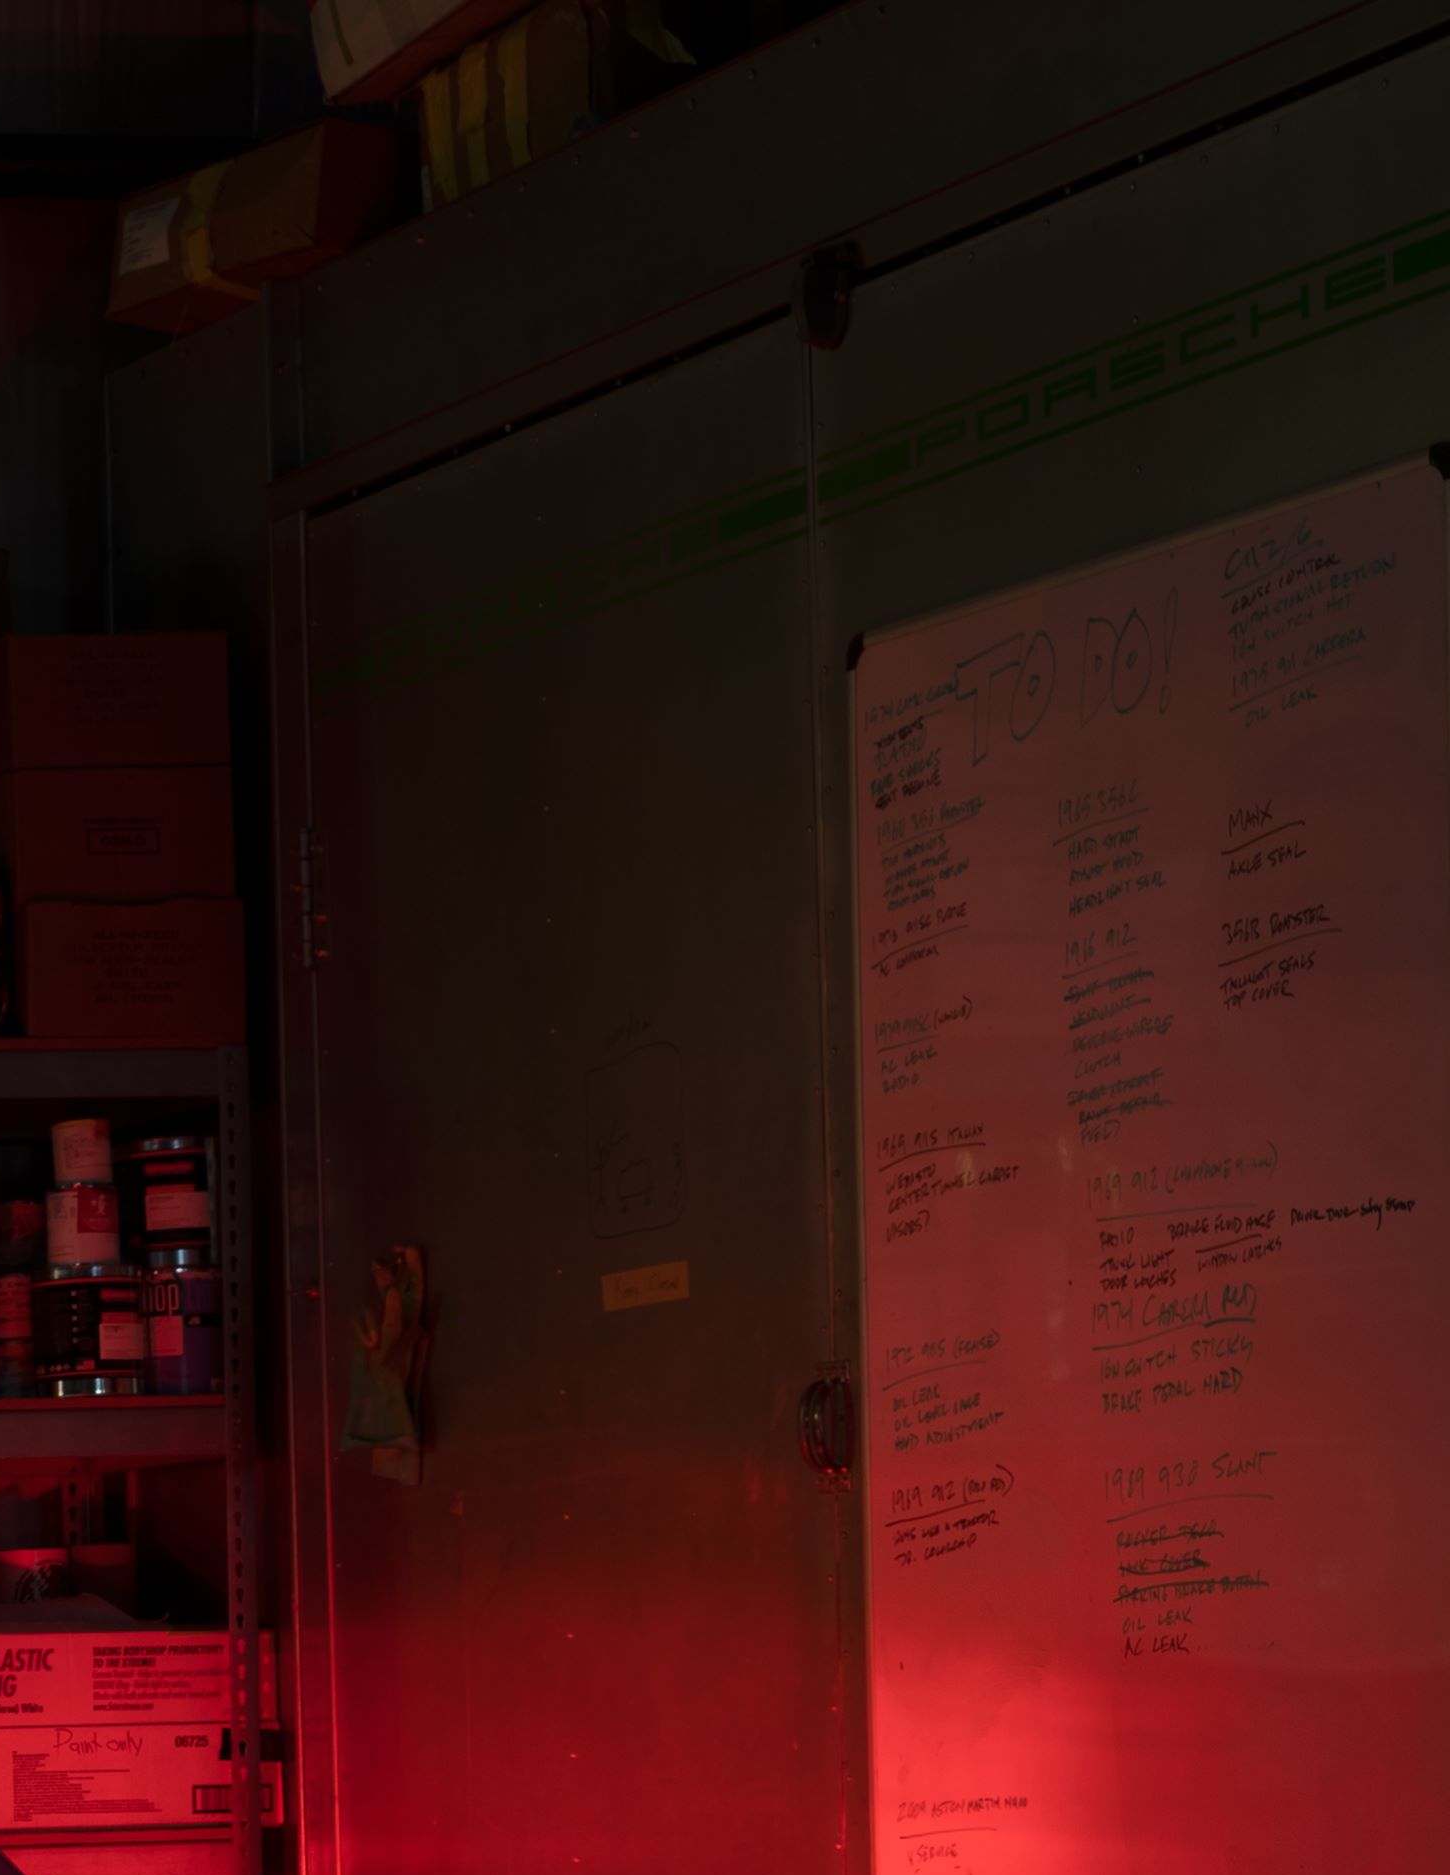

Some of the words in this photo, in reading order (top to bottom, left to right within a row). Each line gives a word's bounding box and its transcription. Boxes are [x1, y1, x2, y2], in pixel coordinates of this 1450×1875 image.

[916, 254, 1388, 467] PORSCHE
[954, 628, 1056, 766] TO
[1228, 799, 1273, 838] MANX
[1190, 1333, 1255, 1364] STICKY
[1203, 1366, 1243, 1396] HARD
[1211, 1451, 1278, 1480] SLANT
[1121, 1615, 1147, 1636] OIL
[1157, 1605, 1194, 1627] LEAK
[1123, 1635, 1143, 1659] AC
[1151, 1632, 1191, 1655] LEAK
[52, 1728, 102, 1755] Paint
[106, 1729, 144, 1756] only
[173, 1734, 209, 1748] 06725
